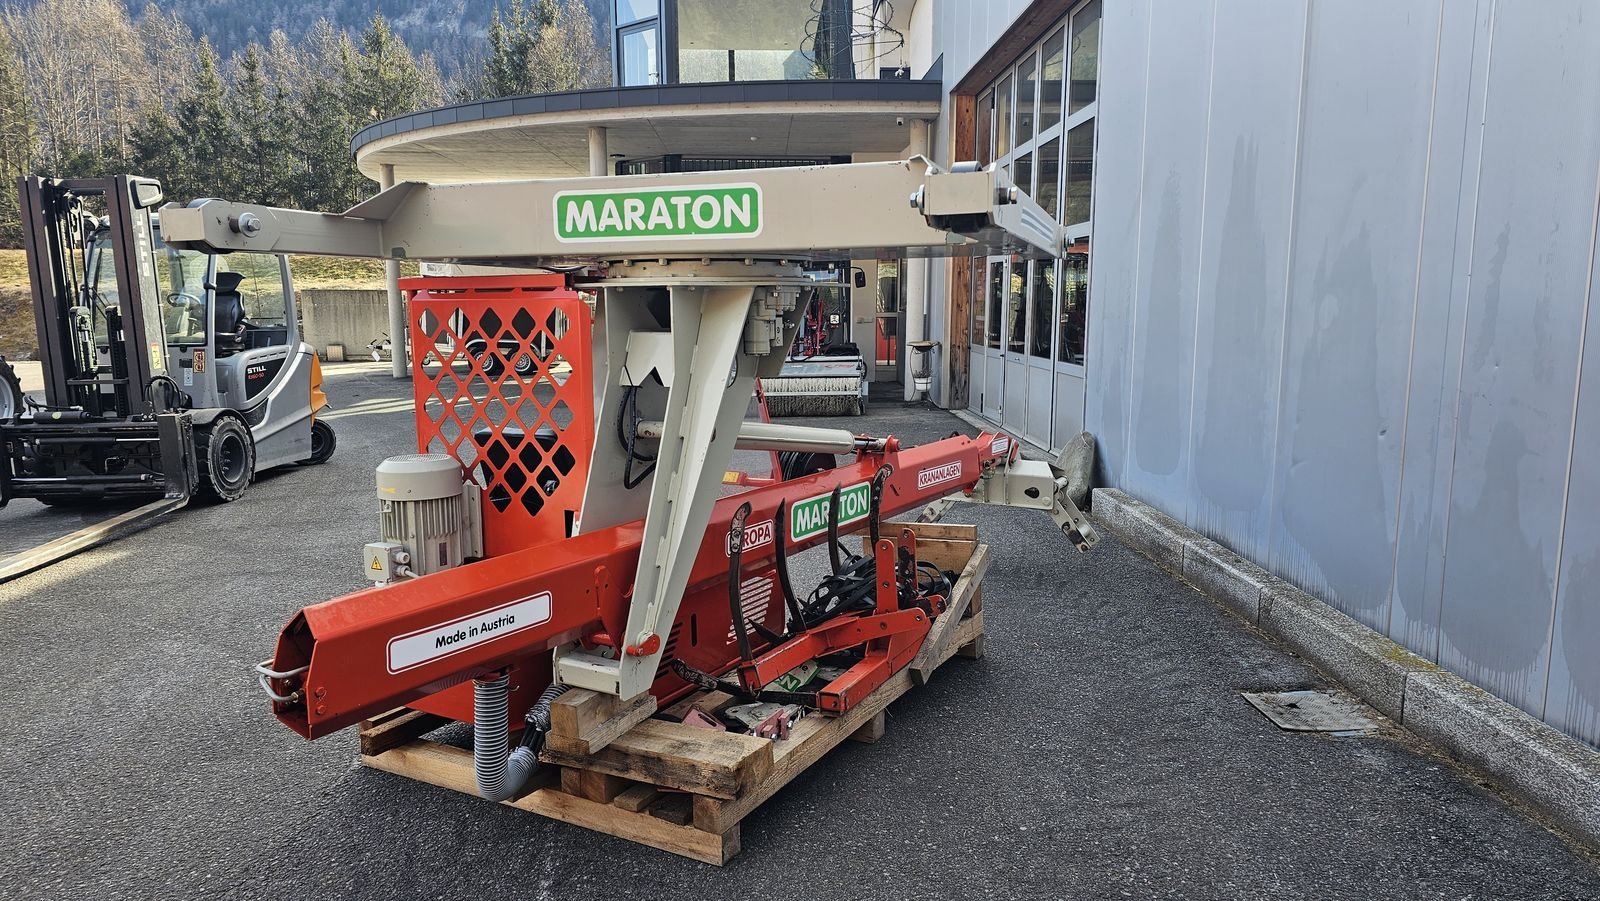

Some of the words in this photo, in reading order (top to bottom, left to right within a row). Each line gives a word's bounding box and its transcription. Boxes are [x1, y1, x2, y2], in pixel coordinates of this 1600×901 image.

[565, 193, 750, 232] MARATON
[137, 213, 150, 277] STILL
[247, 365, 267, 374] STILL
[919, 463, 961, 486] KRANANLAGEN
[796, 488, 867, 534] MARTON
[734, 524, 771, 549] ROPA
[435, 629, 467, 649] Made
[468, 625, 479, 638] in
[480, 613, 515, 634] Austria
